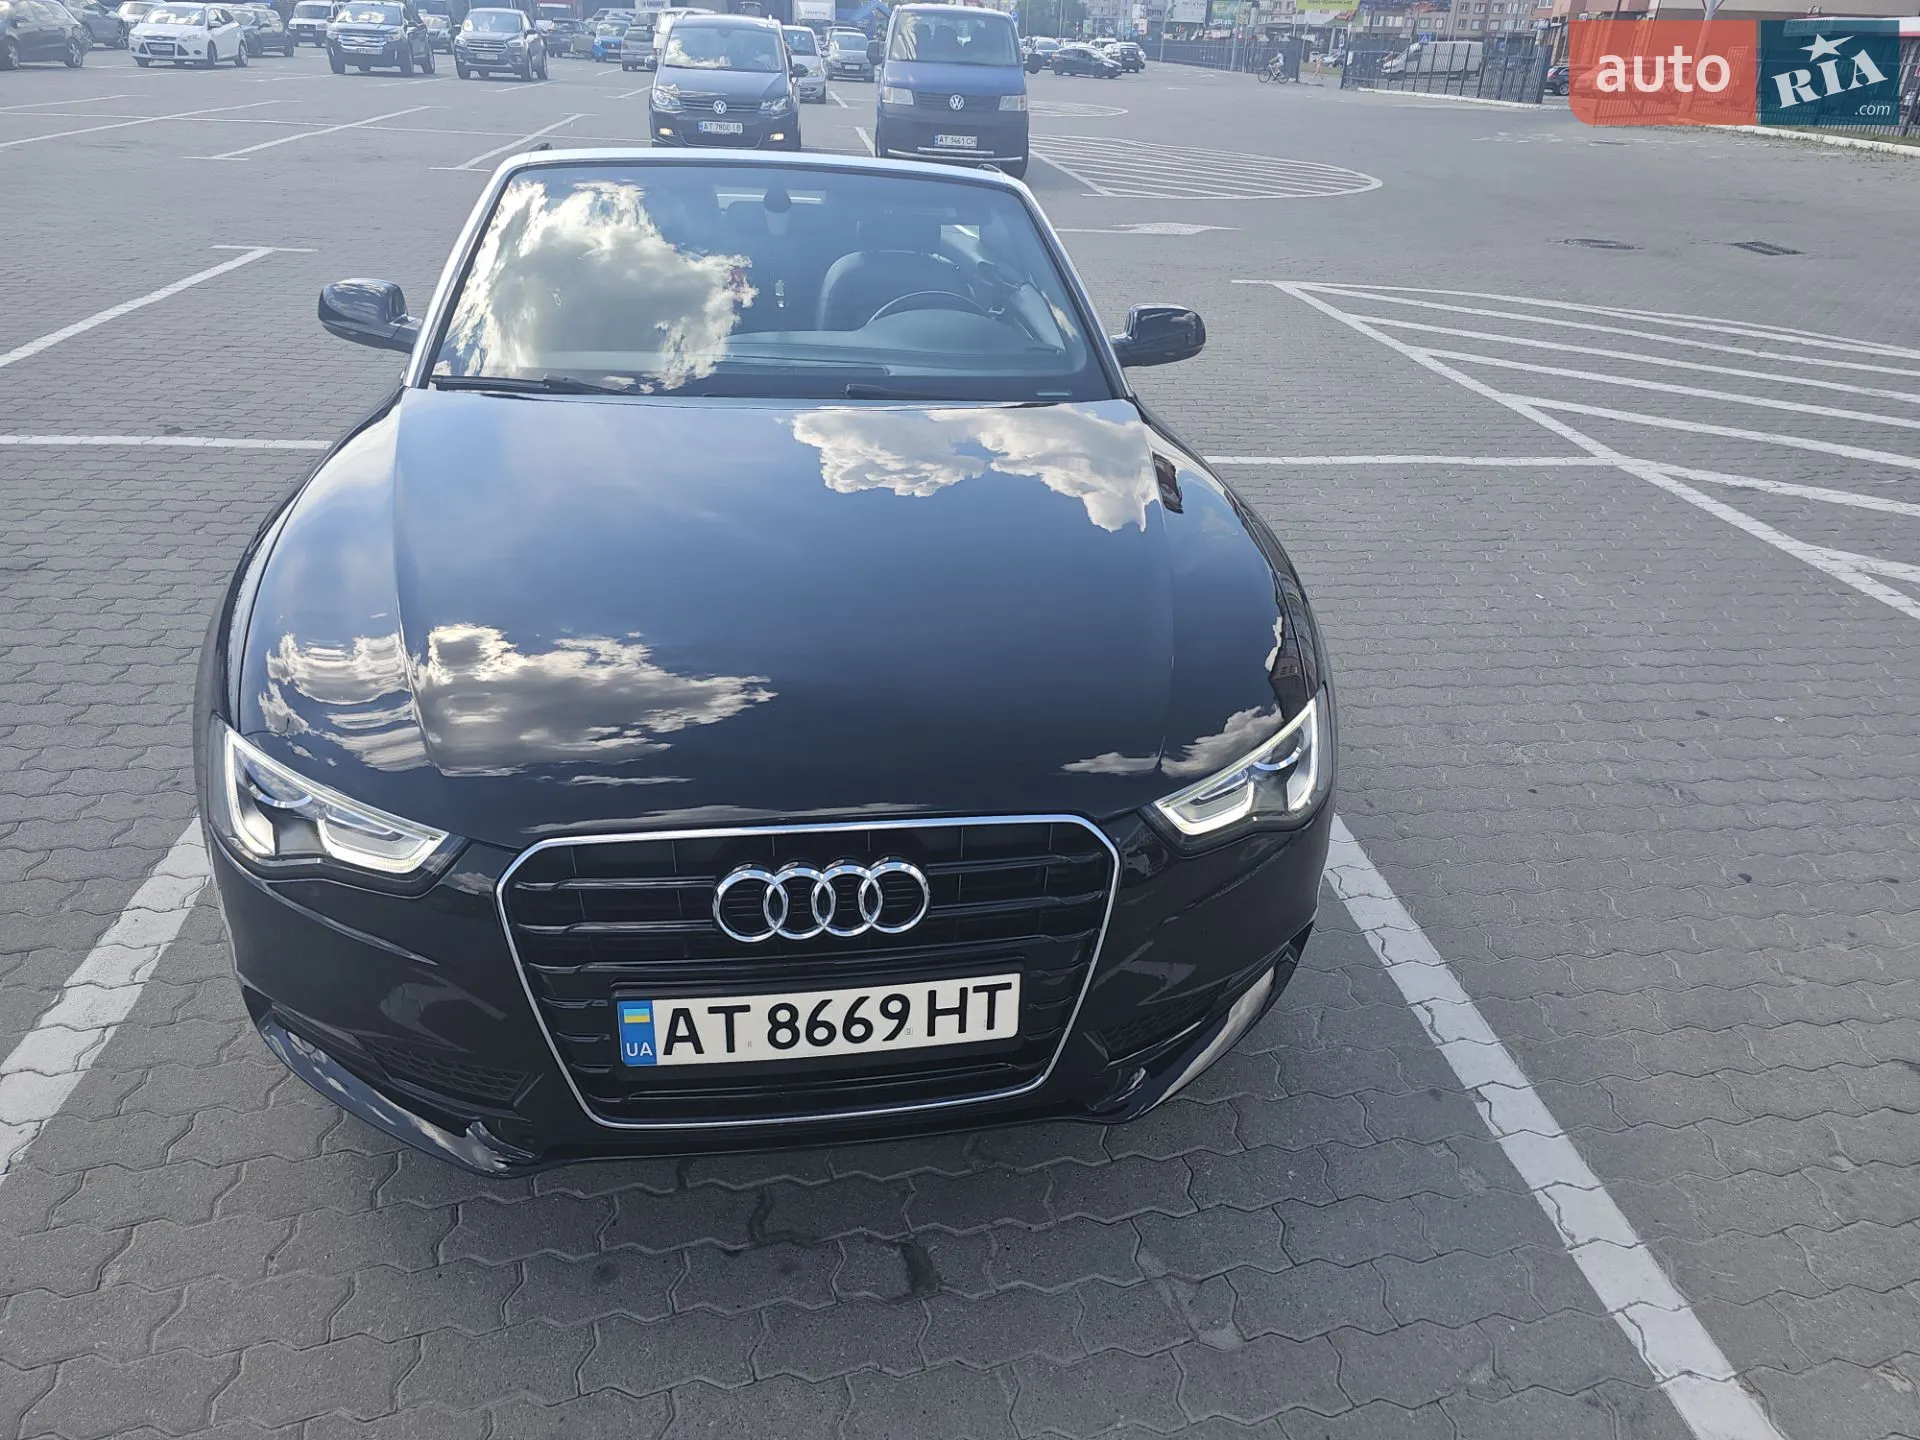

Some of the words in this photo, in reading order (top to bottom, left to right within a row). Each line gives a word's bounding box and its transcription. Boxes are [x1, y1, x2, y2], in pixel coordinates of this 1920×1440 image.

[663, 1005, 751, 1056] AT
[767, 993, 911, 1050] 8669
[927, 982, 1012, 1037] HT
[626, 1042, 653, 1057] UA
